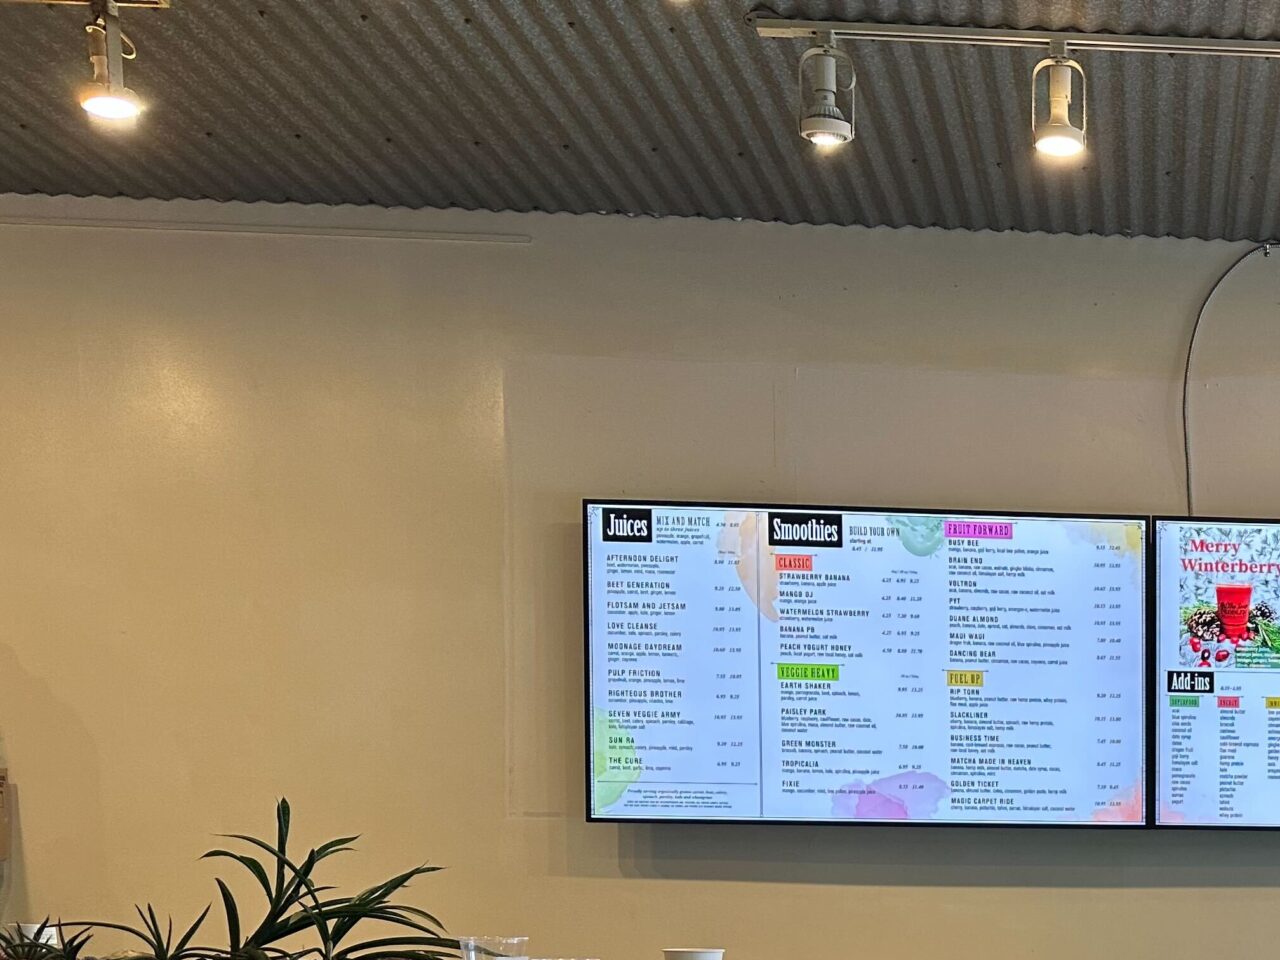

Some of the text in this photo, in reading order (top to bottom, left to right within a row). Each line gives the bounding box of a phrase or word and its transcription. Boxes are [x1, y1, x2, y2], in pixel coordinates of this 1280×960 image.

[606, 514, 648, 537] Juices
[656, 516, 710, 527] MIX AND MATCH
[773, 517, 839, 541] Smoothies
[948, 523, 1009, 536] FRUIT FORWARD
[1190, 539, 1240, 557] Merry
[606, 555, 678, 564] AFTERNOON DELIGHT
[779, 558, 810, 568] CLASSIC
[607, 602, 639, 610] FLOTSAM
[642, 602, 656, 610] AND
[607, 622, 658, 631] LOVE CLEANSE
[608, 669, 626, 677] PULP
[781, 667, 836, 679] VEGGIE HEAVY
[950, 673, 981, 684] FUEL UP
[1171, 673, 1210, 690] Add-ins
[608, 710, 631, 718] SEVEN
[661, 711, 681, 719] ARMY
